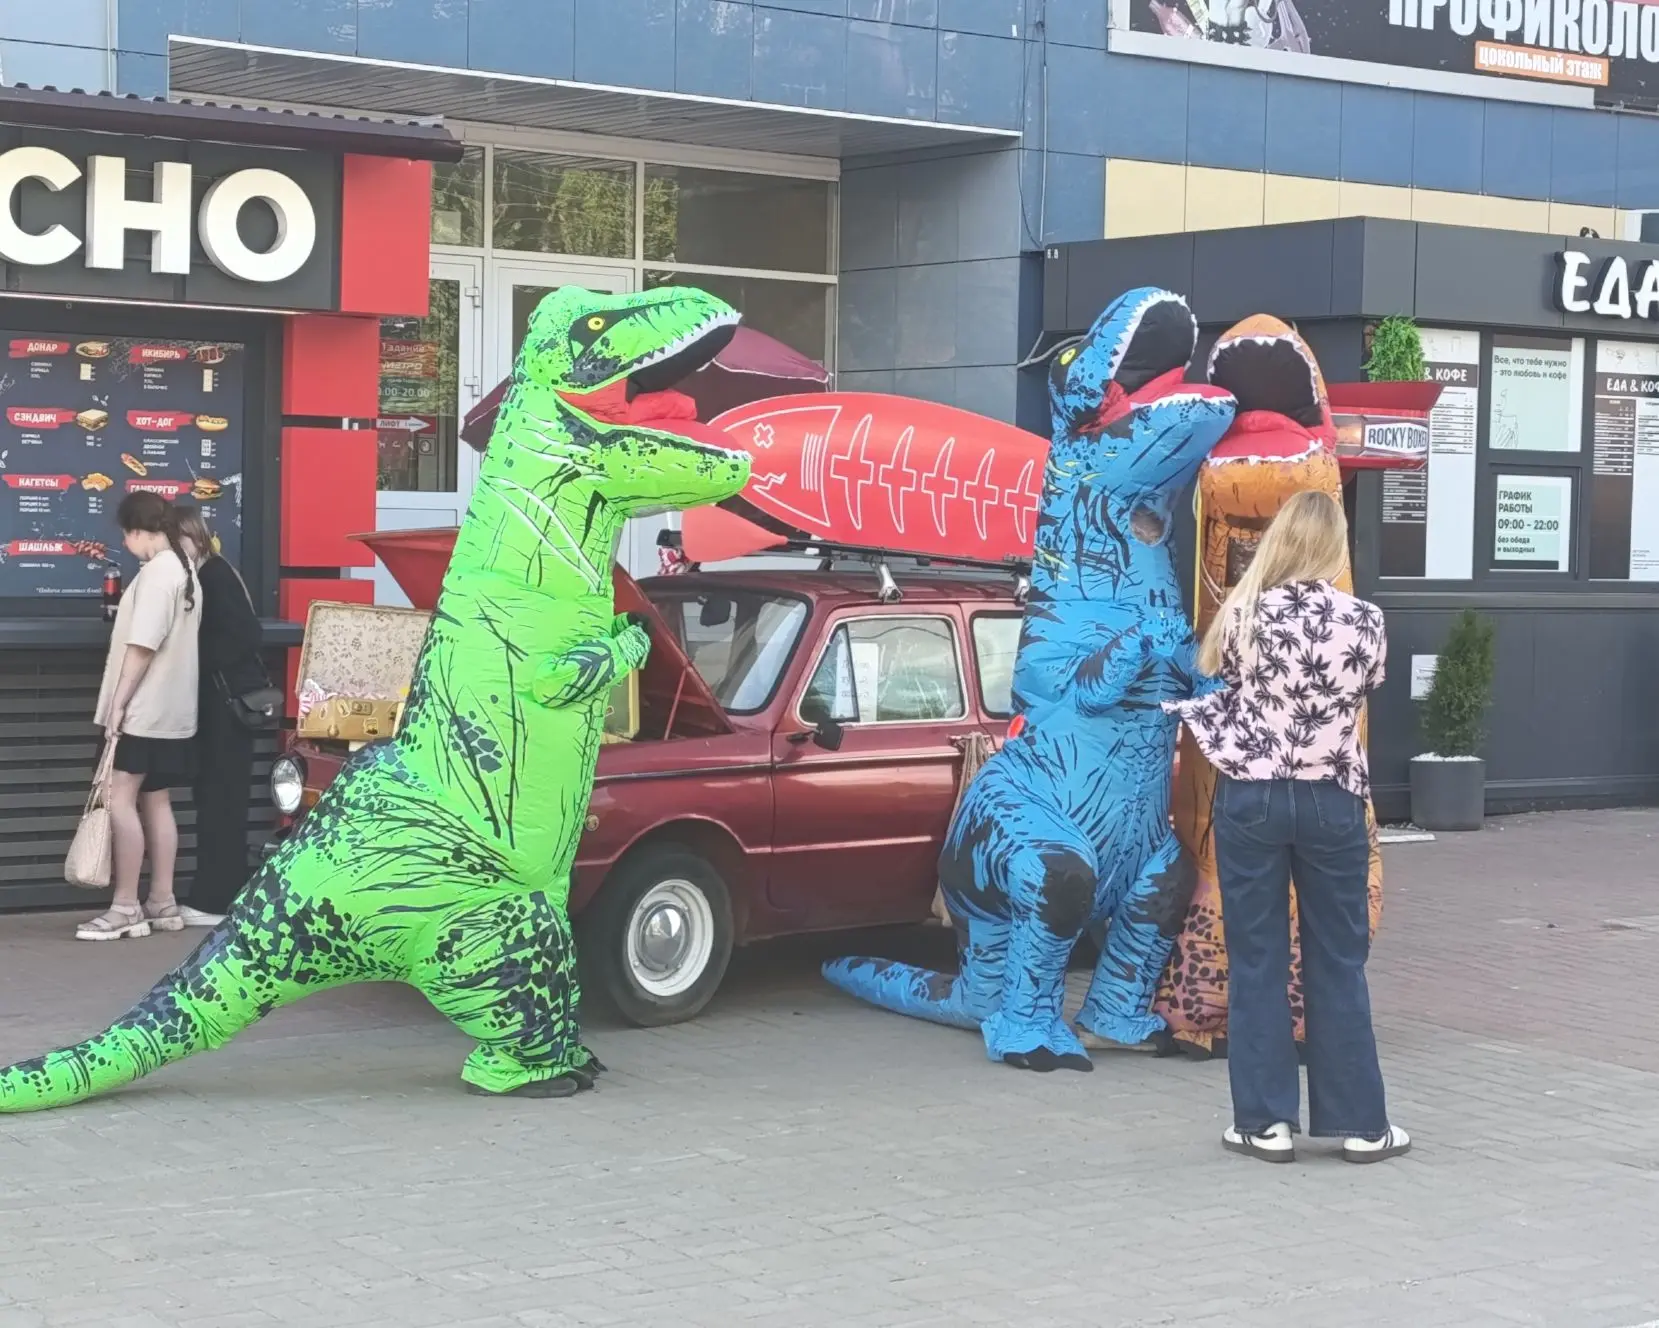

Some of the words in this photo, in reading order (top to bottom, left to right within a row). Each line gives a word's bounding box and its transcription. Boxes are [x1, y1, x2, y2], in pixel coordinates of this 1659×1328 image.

[0, 146, 316, 283] СНО
[1554, 250, 1659, 319] ЕДА
[27, 342, 58, 353] ДОНАР
[1494, 354, 1511, 366] Все,
[1512, 358, 1525, 366] что
[1526, 356, 1543, 366] тебе
[1544, 359, 1567, 369] нужно
[1435, 368, 1468, 382] КОФЕ
[1499, 369, 1512, 377] это
[1513, 369, 1541, 378] любовь
[1549, 370, 1567, 380] кофе
[1606, 377, 1628, 392] ЕДА
[1629, 379, 1639, 393] &
[14, 412, 57, 423] СЭНДВИЧ
[135, 417, 174, 428] ХОТ-ДОГ
[1368, 426, 1406, 449] ROCKY
[18, 477, 59, 488] НАГЕТСЫ
[1498, 490, 1532, 501] ГРАФИК
[1498, 502, 1533, 513] РАБОТЫ
[1497, 518, 1525, 530] 09:00
[1533, 519, 1559, 531] 22:00
[1497, 535, 1509, 544] без
[1510, 536, 1530, 544] обеда
[18, 542, 64, 552] ШАШЛЫК
[1502, 546, 1535, 554] выходных
